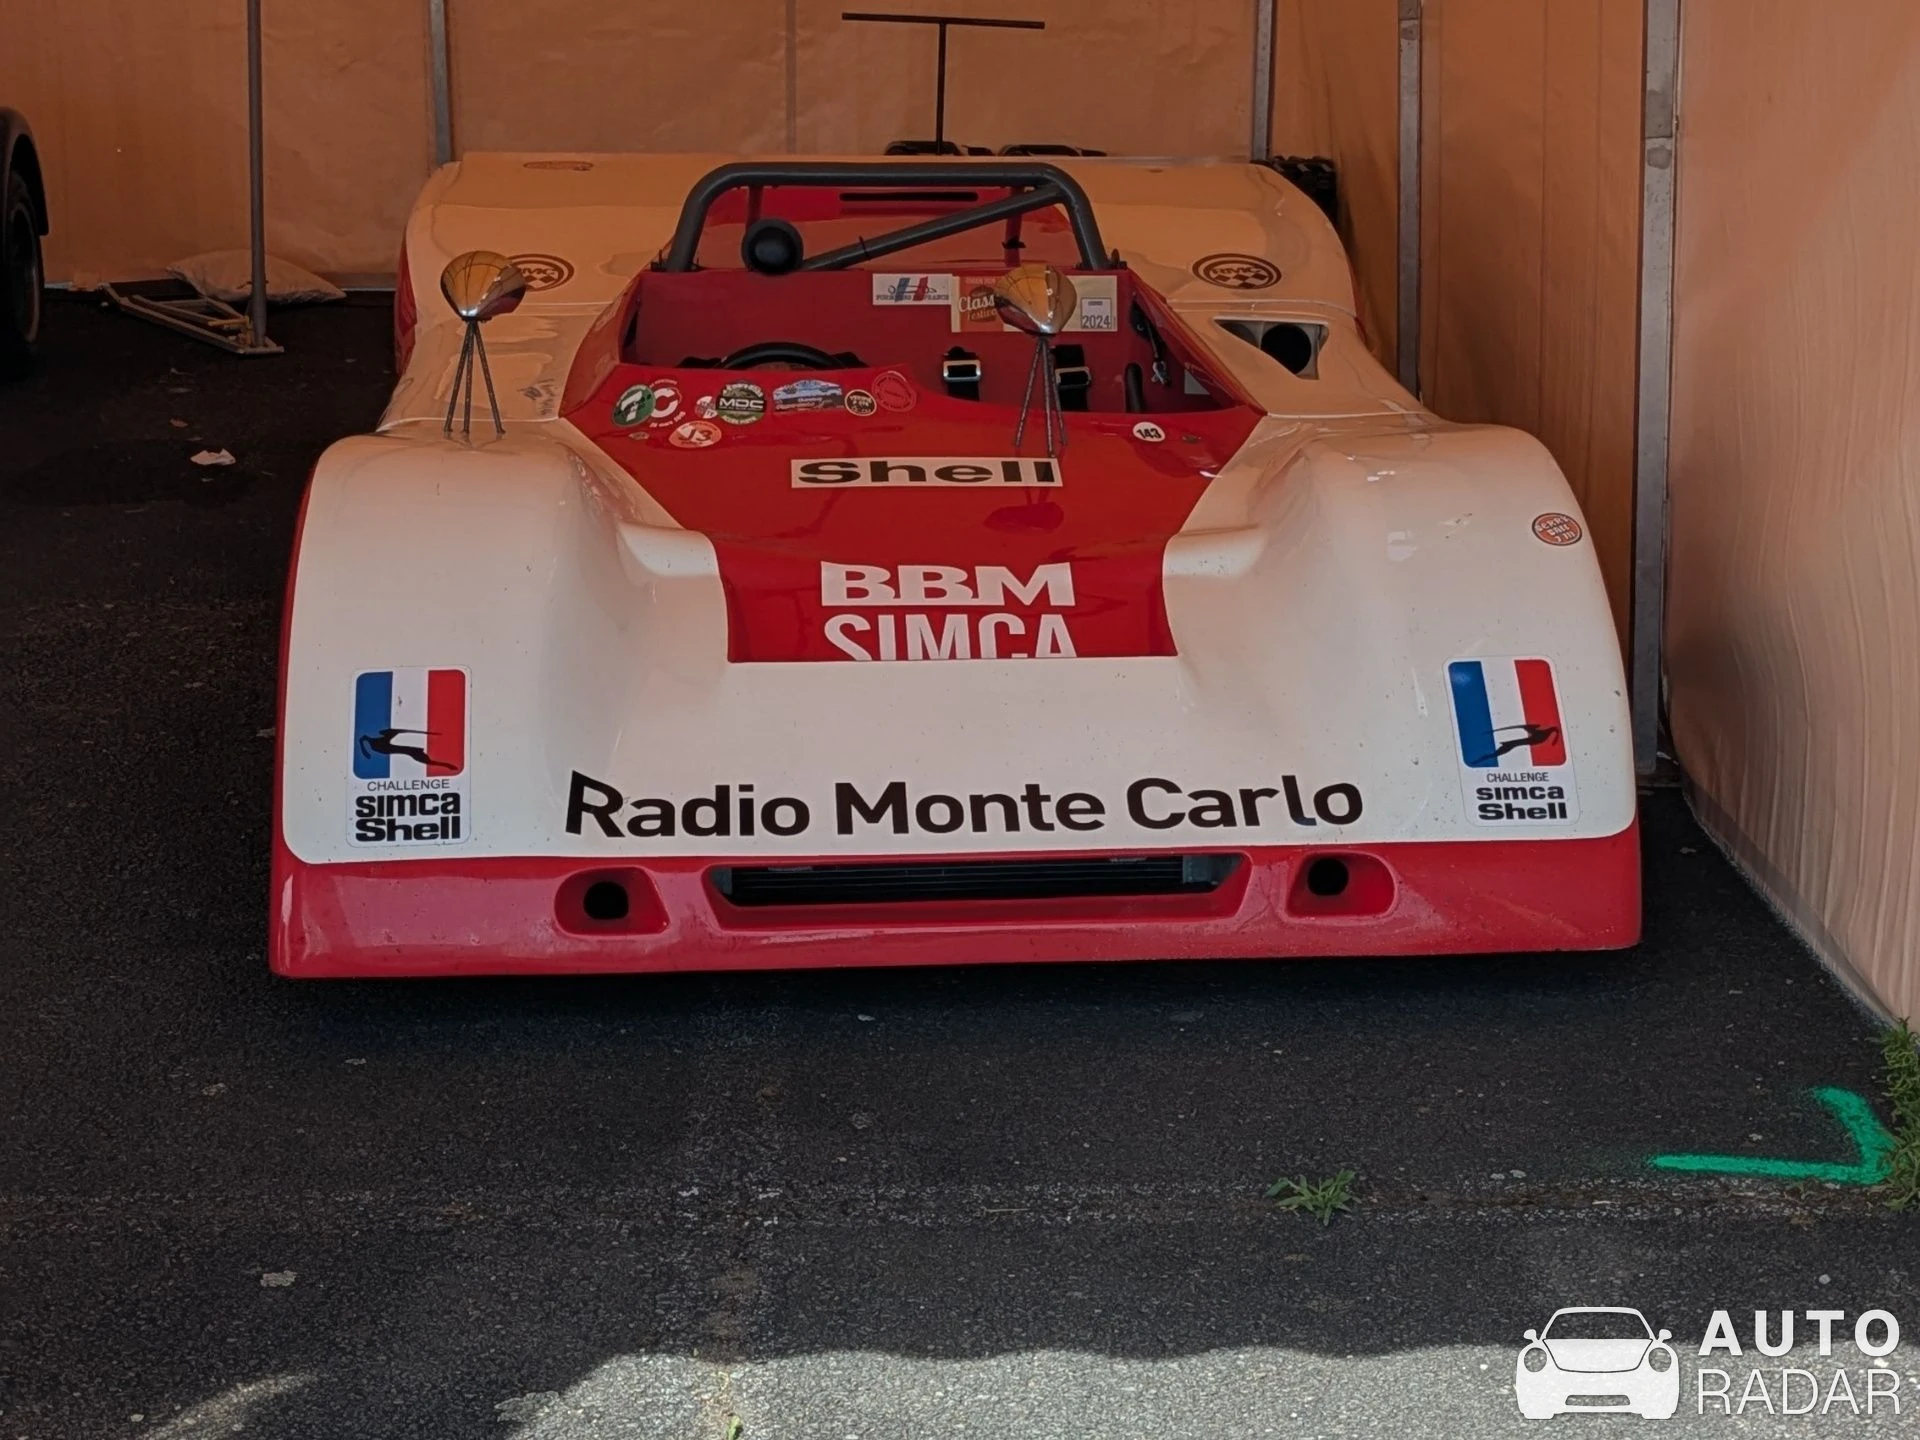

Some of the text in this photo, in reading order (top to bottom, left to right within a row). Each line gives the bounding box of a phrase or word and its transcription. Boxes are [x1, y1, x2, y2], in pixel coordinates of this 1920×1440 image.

[1081, 314, 1111, 329] 2024
[798, 460, 1055, 484] Shell
[820, 561, 1076, 607] BBM
[823, 612, 1078, 661] SIMCA
[367, 779, 450, 792] CHALLENGE
[1486, 771, 1549, 783] CHALLENGE
[355, 792, 460, 818] simca
[565, 770, 1362, 838] Radio Monte Carlo
[1476, 786, 1564, 801] simca
[1478, 802, 1567, 820] Shell
[355, 816, 460, 842] Shell
